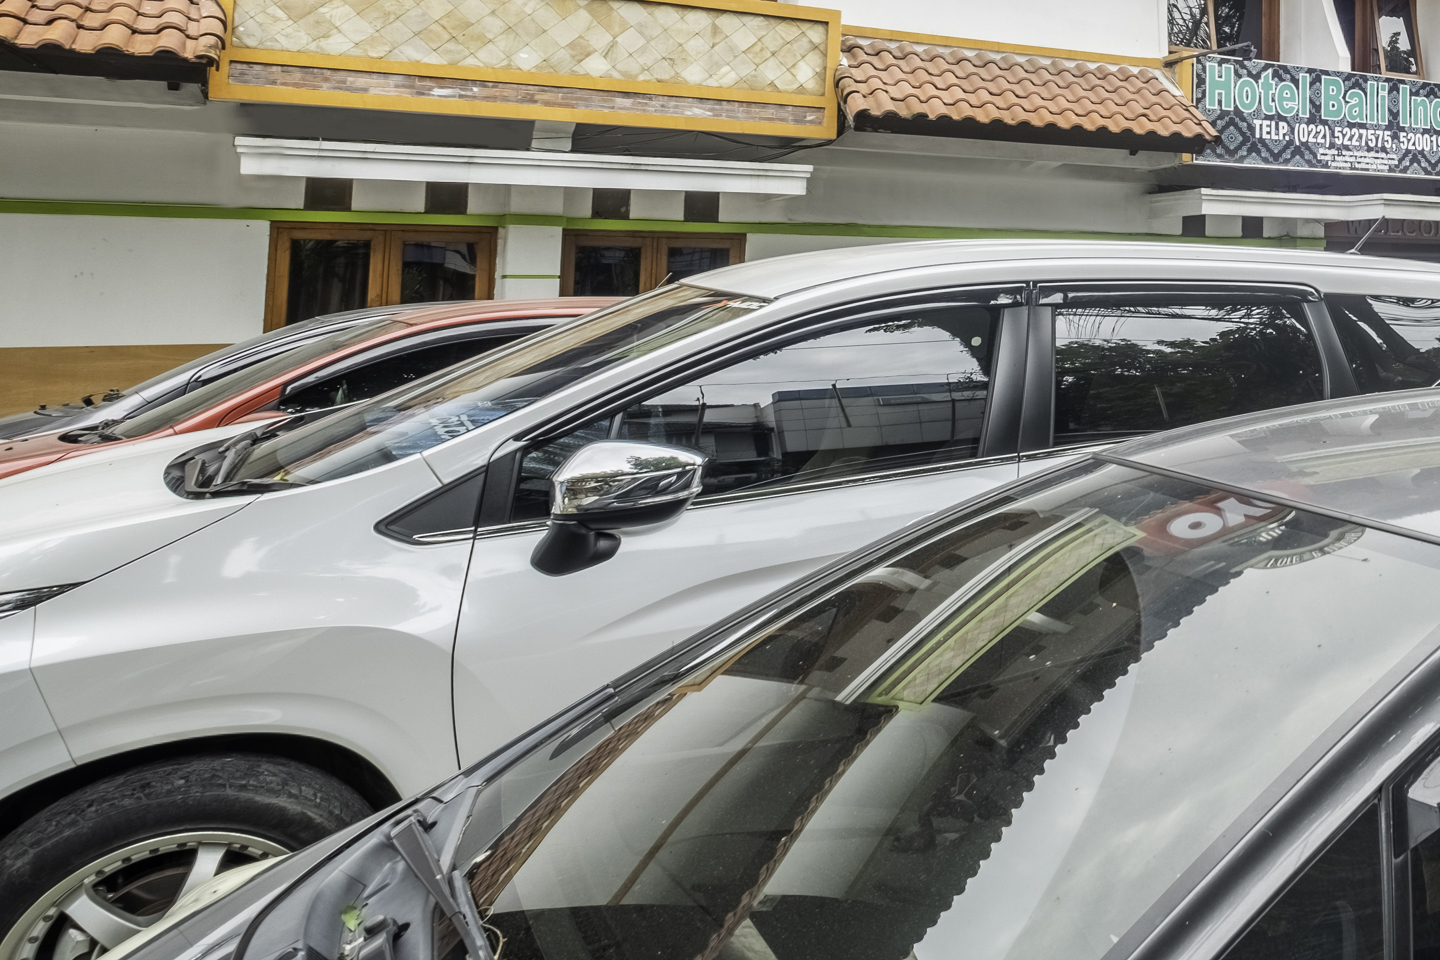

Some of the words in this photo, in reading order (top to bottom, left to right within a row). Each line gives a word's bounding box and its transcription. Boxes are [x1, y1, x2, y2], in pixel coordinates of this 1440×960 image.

[1206, 62, 1310, 118] Hotel
[1322, 75, 1389, 126] Bali
[1253, 119, 1289, 140] TELP.
[1294, 123, 1330, 147] (022)
[1334, 127, 1398, 152] 5227575,
